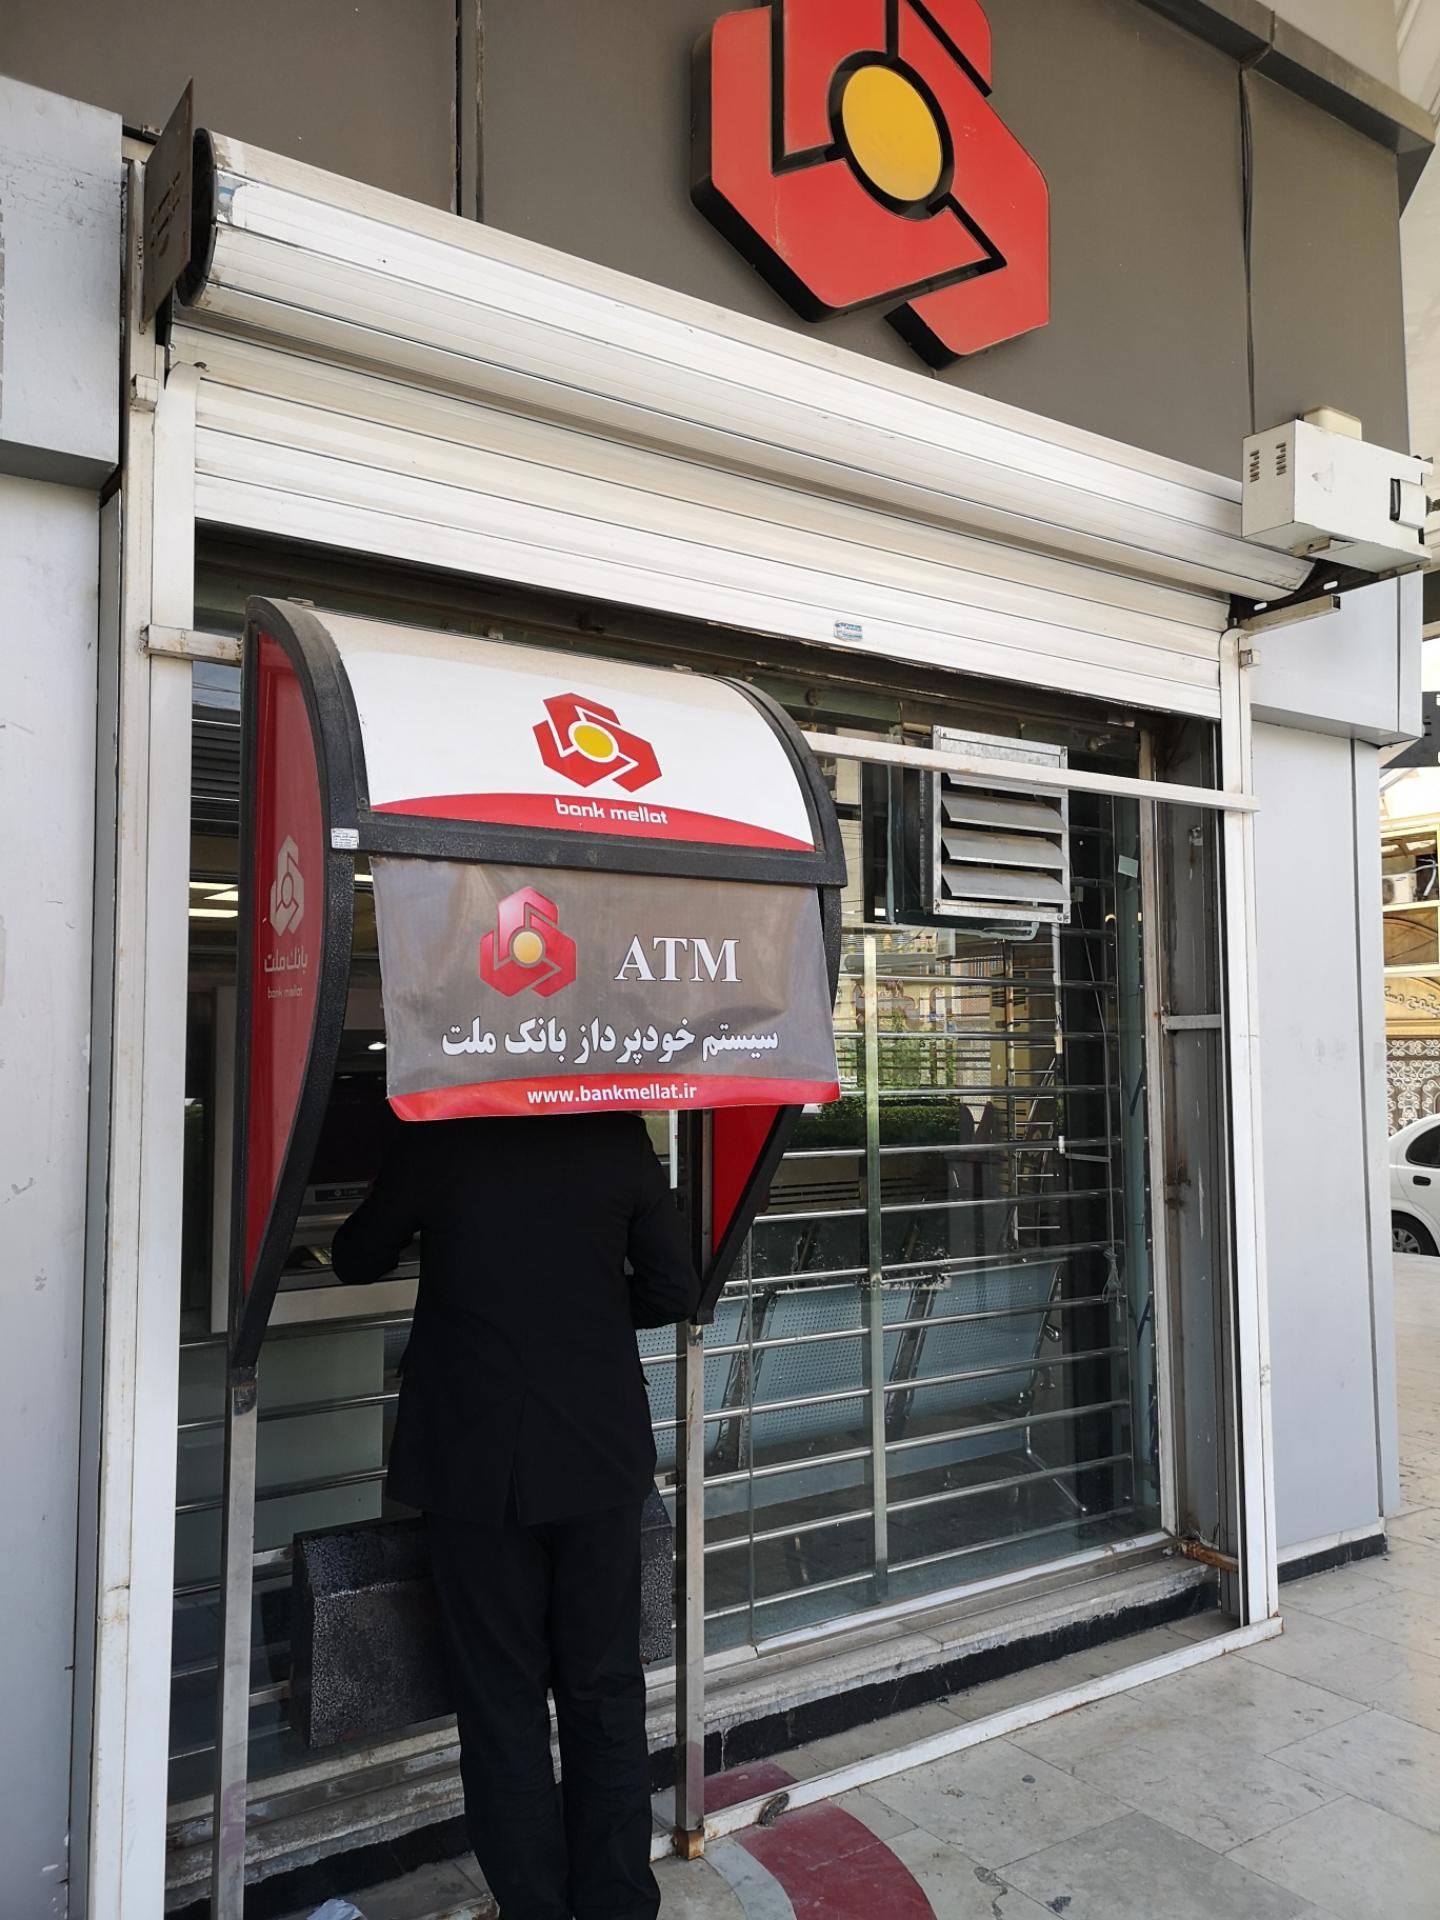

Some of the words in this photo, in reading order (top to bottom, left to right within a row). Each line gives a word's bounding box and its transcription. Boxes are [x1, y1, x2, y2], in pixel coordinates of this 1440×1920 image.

[554, 797, 606, 818] bank
[610, 805, 669, 824] mellat
[264, 948, 286, 973] ملت
[614, 935, 742, 982] ATM
[441, 1016, 498, 1057] ملت
[504, 1016, 568, 1063] بانک
[573, 1016, 697, 1066] خودپرداز
[702, 1022, 779, 1063] سیستم
[527, 1082, 698, 1104] www.bankmellat.ir
